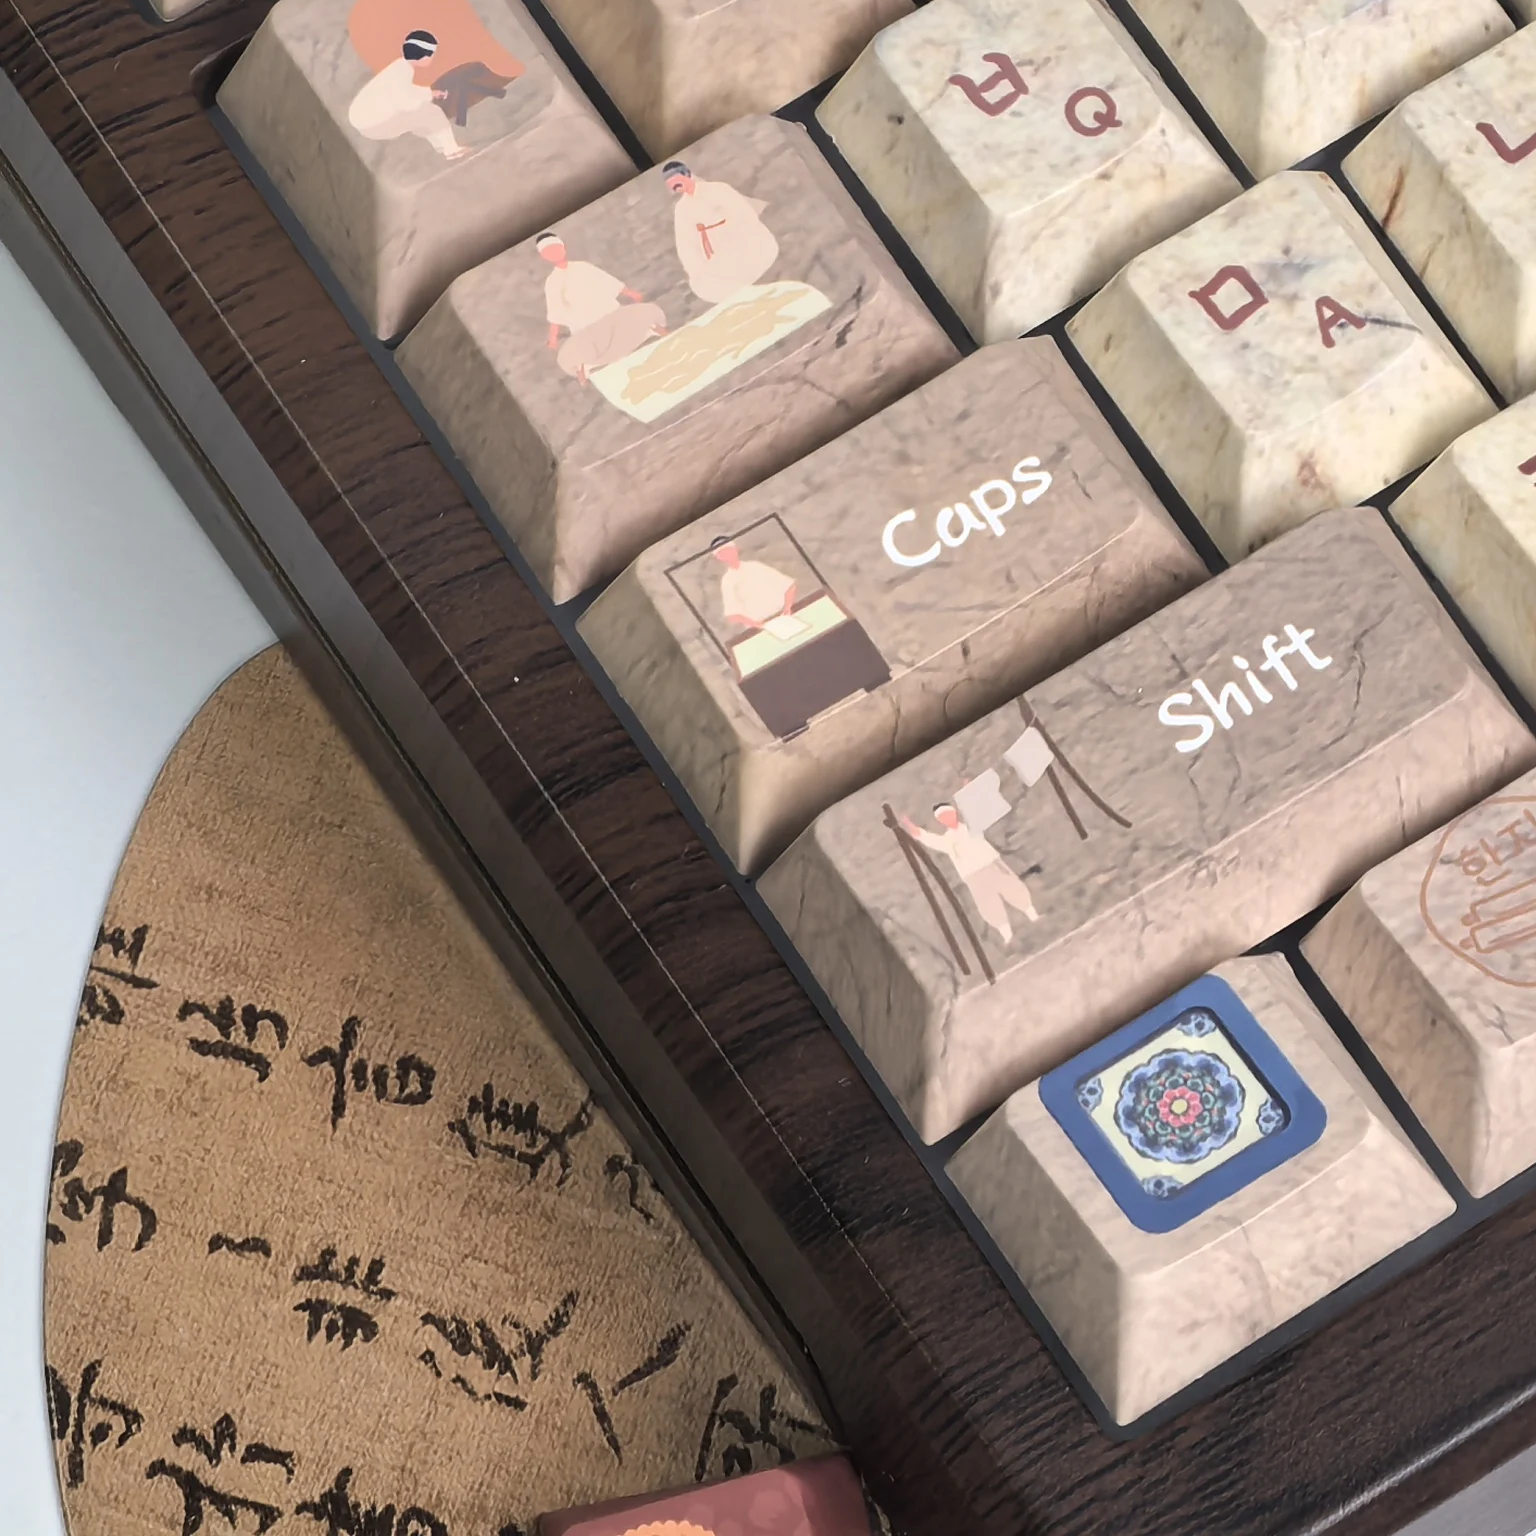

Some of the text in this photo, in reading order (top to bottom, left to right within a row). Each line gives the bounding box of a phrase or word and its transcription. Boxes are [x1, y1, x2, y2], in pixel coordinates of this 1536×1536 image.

[1064, 87, 1120, 137] Q
[1315, 297, 1365, 349] A
[882, 457, 1053, 568] Caps
[1158, 623, 1333, 753] Shift
